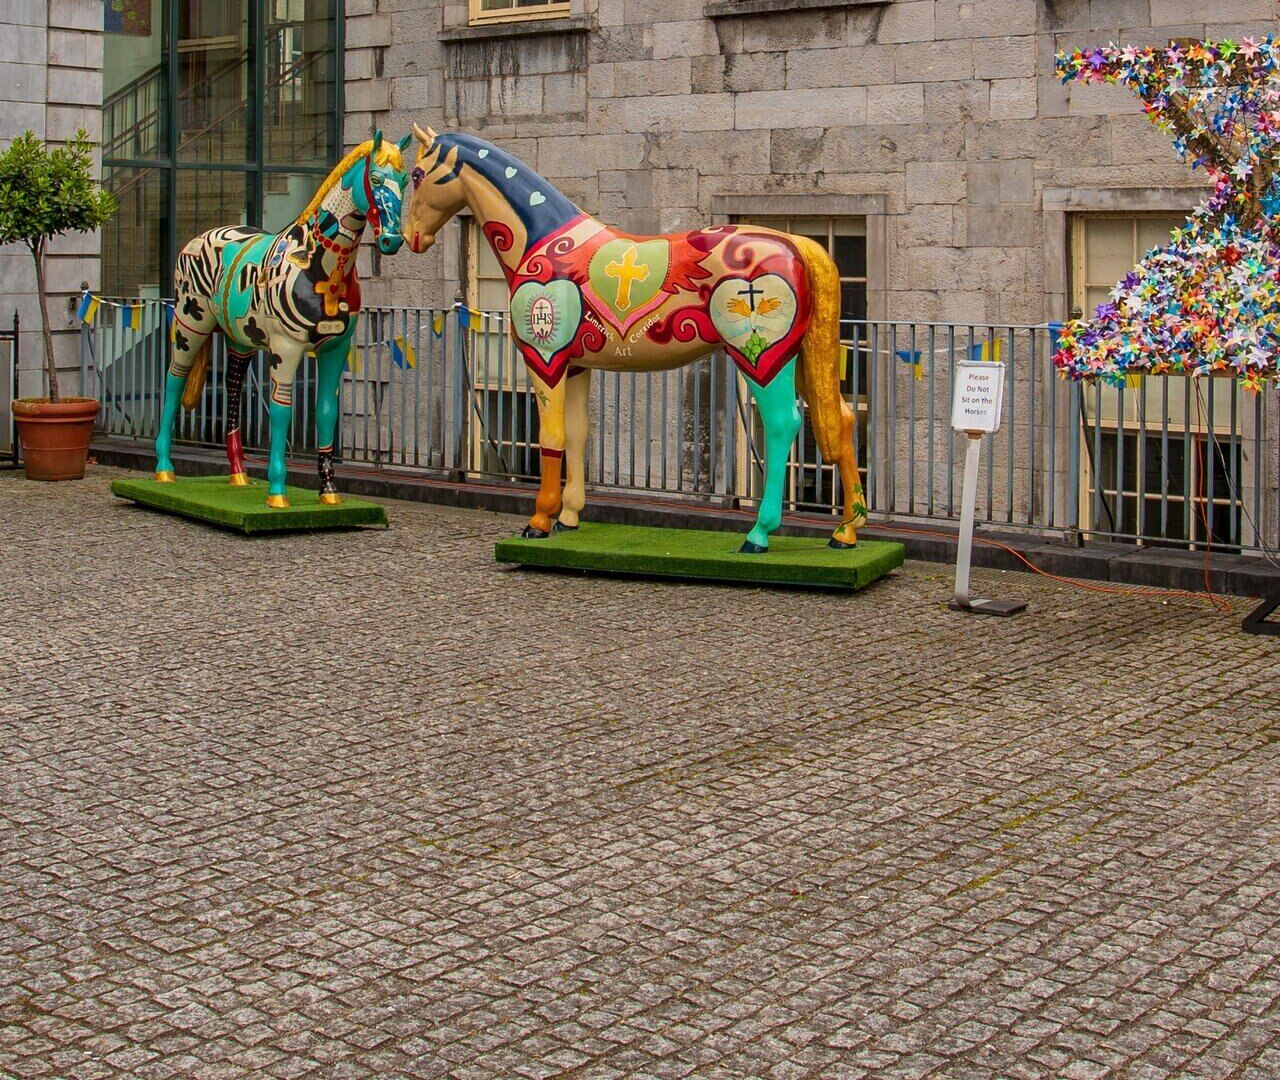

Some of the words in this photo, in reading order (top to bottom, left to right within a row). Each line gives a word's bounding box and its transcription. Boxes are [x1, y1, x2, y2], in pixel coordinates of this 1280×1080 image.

[585, 311, 614, 342] Limerick
[615, 346, 632, 357] Art
[629, 315, 660, 343] Corridor
[969, 373, 989, 381] Please
[966, 385, 976, 393] Do
[961, 396, 970, 404] Sit
[981, 397, 993, 405] the
